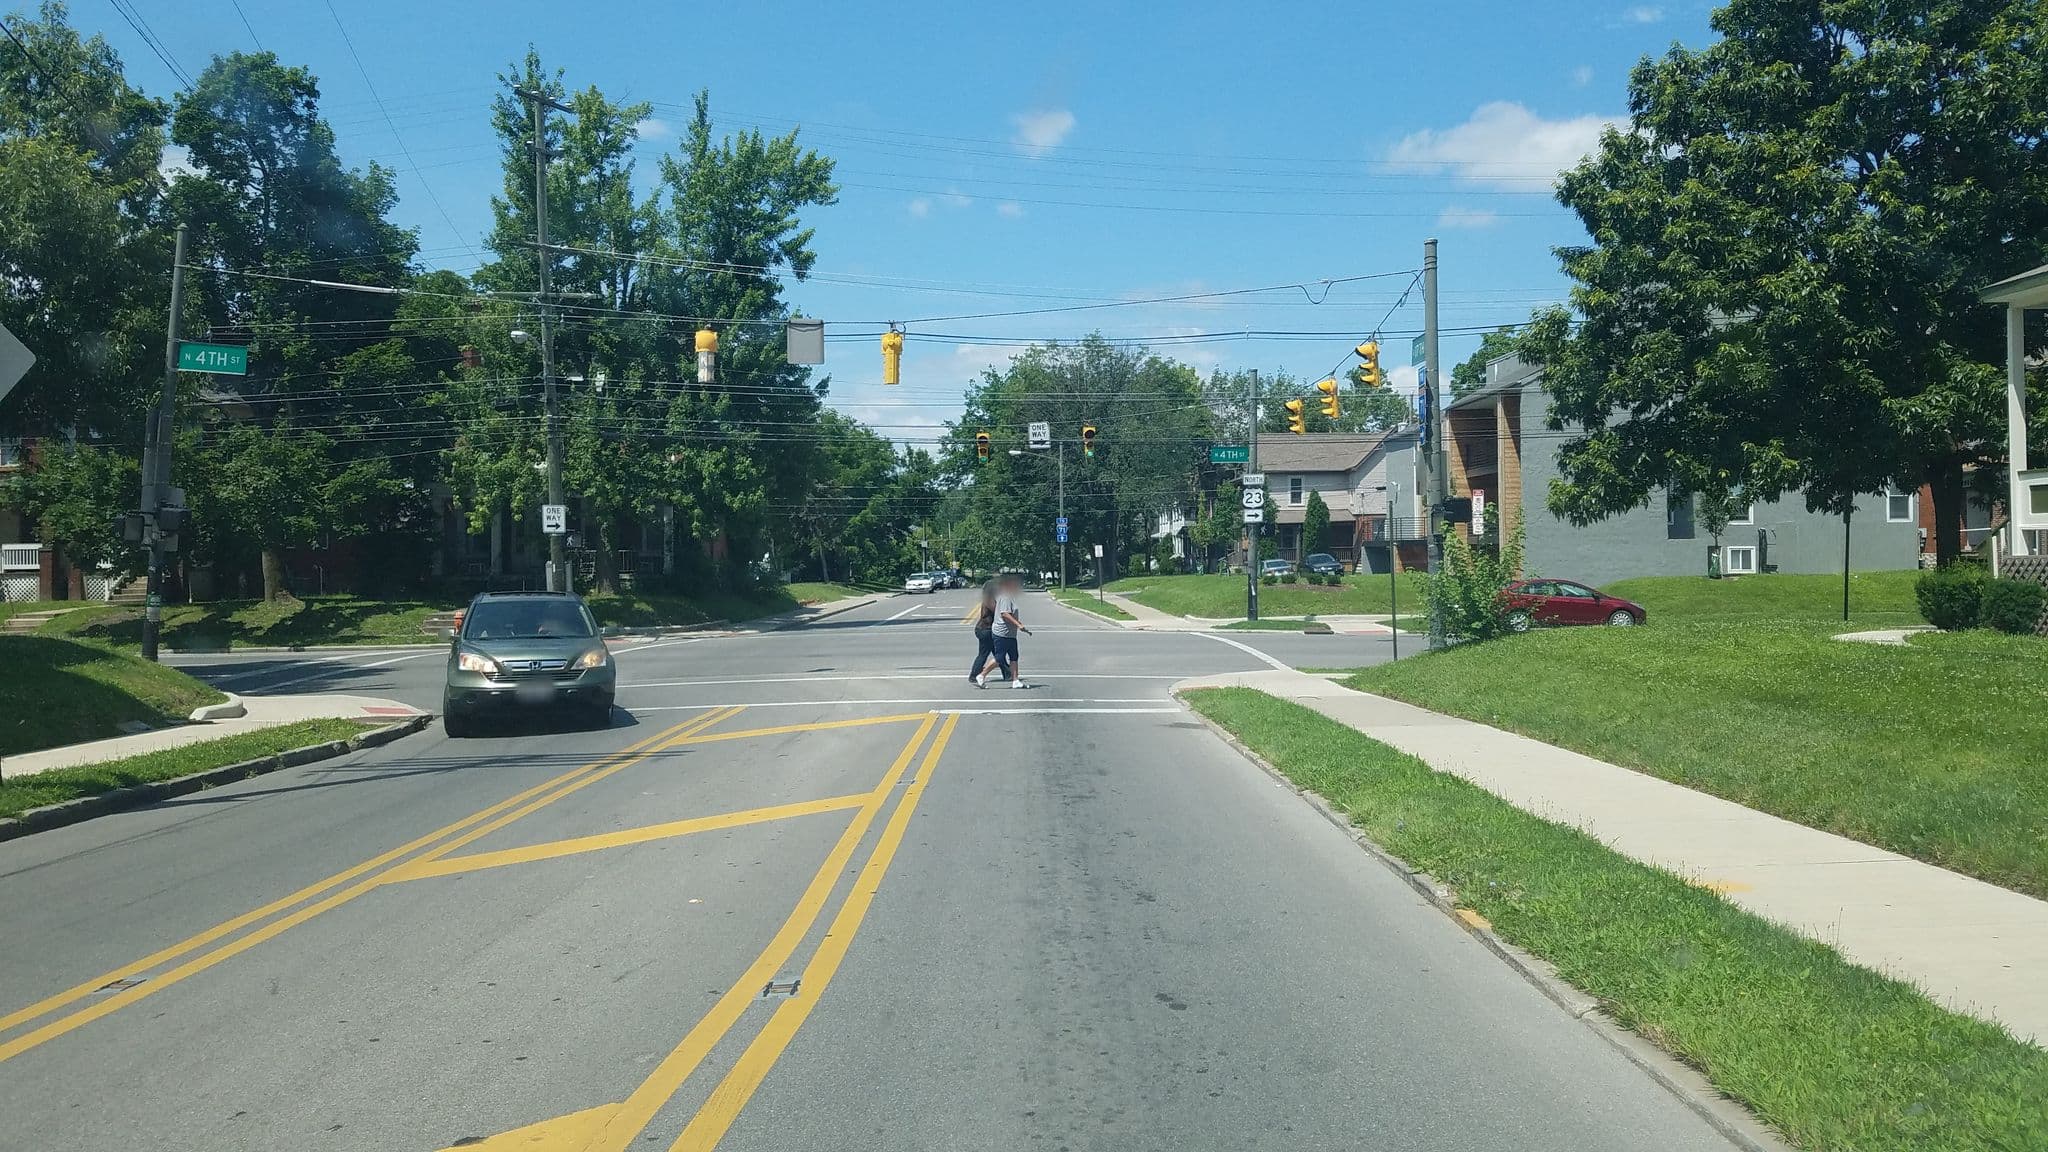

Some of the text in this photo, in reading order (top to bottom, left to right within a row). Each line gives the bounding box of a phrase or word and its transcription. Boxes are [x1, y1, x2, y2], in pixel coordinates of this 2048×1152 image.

[184, 350, 241, 366] N 4TH ST
[1220, 450, 1238, 459] 4TH
[1245, 492, 1262, 504] 23
